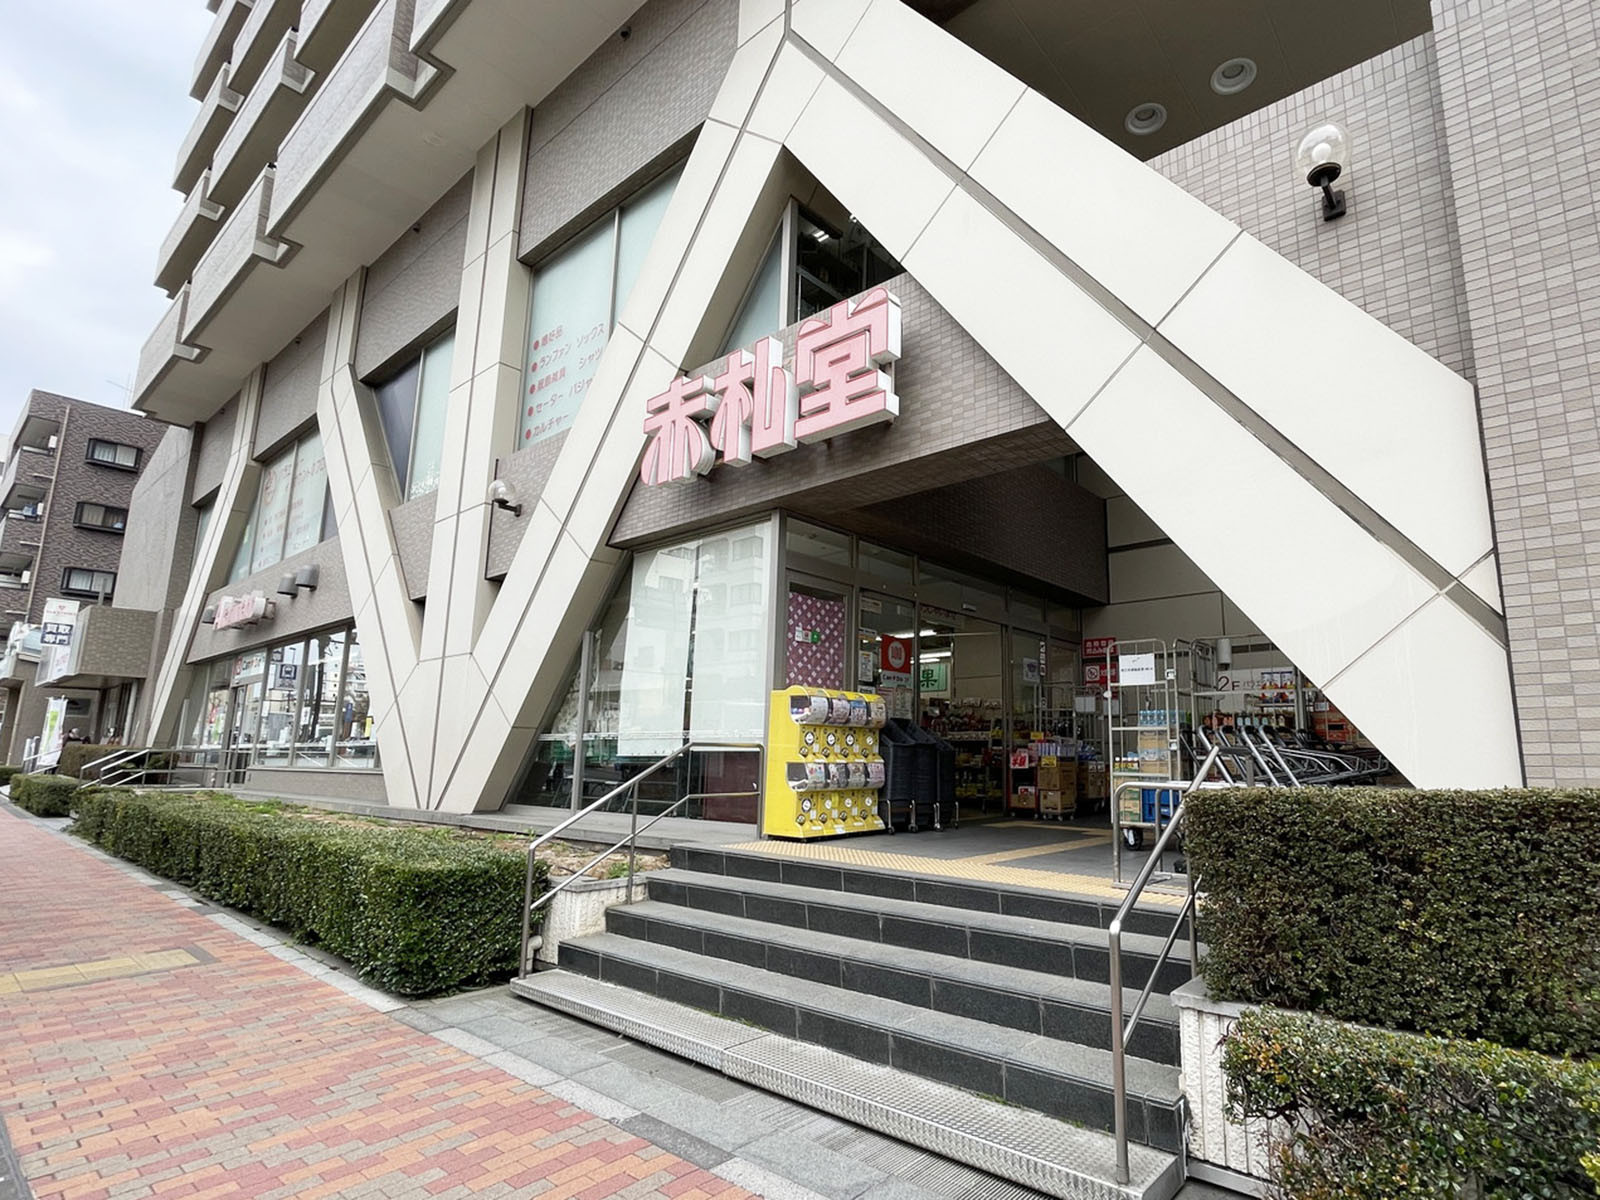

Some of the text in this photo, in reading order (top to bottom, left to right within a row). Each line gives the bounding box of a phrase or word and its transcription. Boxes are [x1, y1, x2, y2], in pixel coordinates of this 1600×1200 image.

[577, 323, 604, 348] ソックス
[579, 346, 603, 369] シャツ
[641, 287, 901, 486] 赤札堂
[536, 393, 563, 413] セーター
[533, 415, 569, 437] カルチャー
[919, 669, 937, 688] 果
